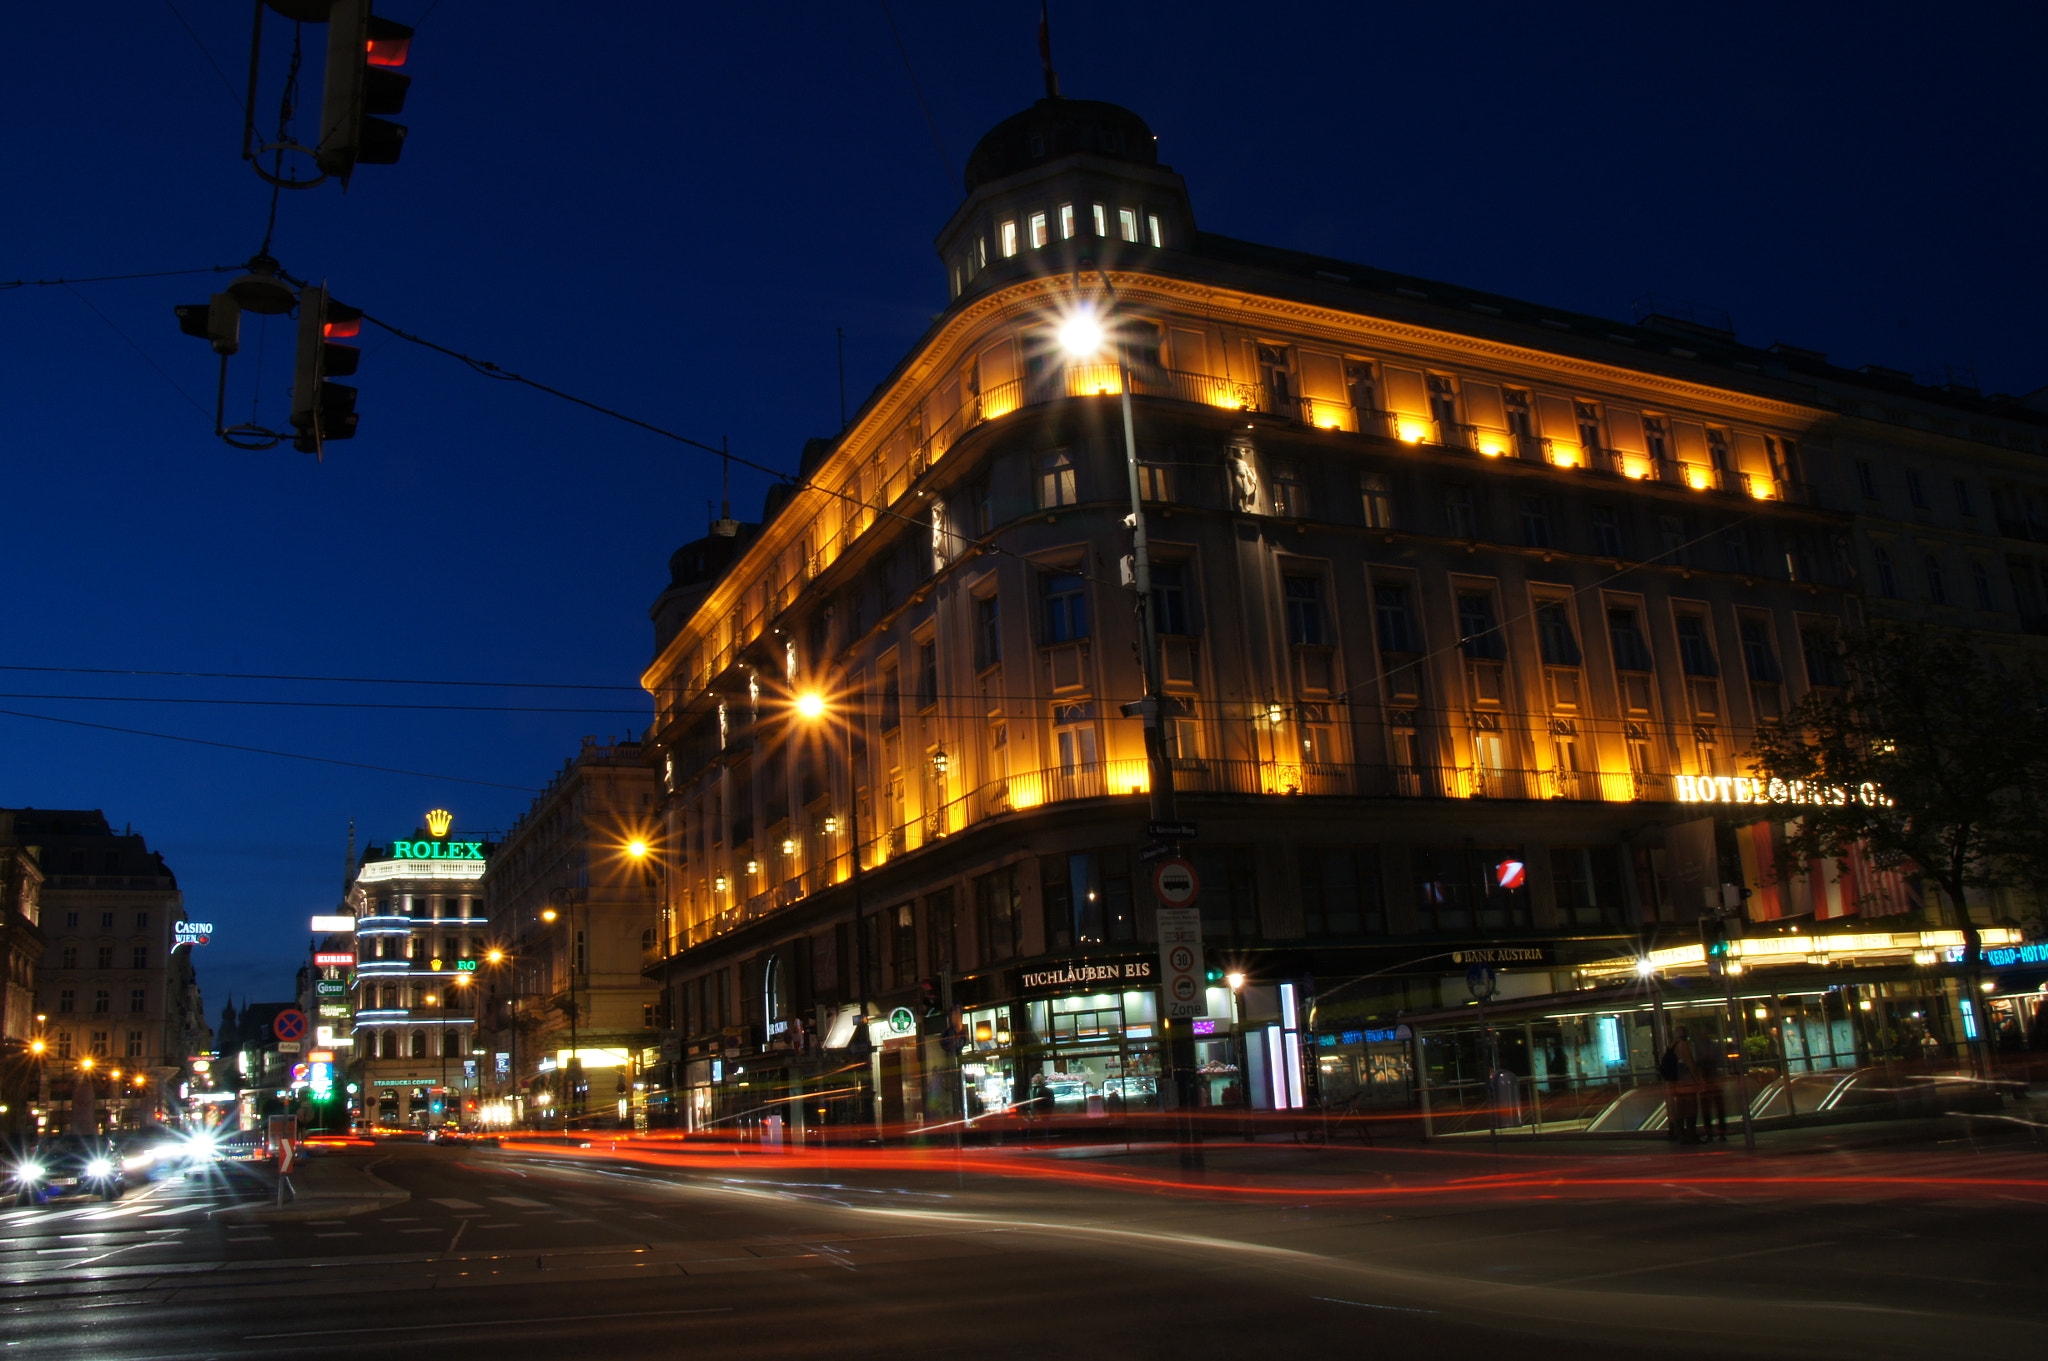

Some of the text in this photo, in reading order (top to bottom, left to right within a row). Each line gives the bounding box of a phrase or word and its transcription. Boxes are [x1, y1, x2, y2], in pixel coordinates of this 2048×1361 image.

[1676, 775, 1893, 806] HOTEL BRISOL
[394, 841, 484, 859] ROLEX
[174, 920, 213, 934] CASINO
[175, 934, 197, 943] WIEN
[317, 955, 353, 963] KURIER
[1176, 953, 1188, 966] 30
[1465, 948, 1543, 962] BANK AUSTRIA
[457, 960, 476, 970] RO
[1022, 963, 1150, 988] TUCHLAUBEN EIS
[317, 982, 344, 994] Gösser
[1170, 1002, 1202, 1016] Zone
